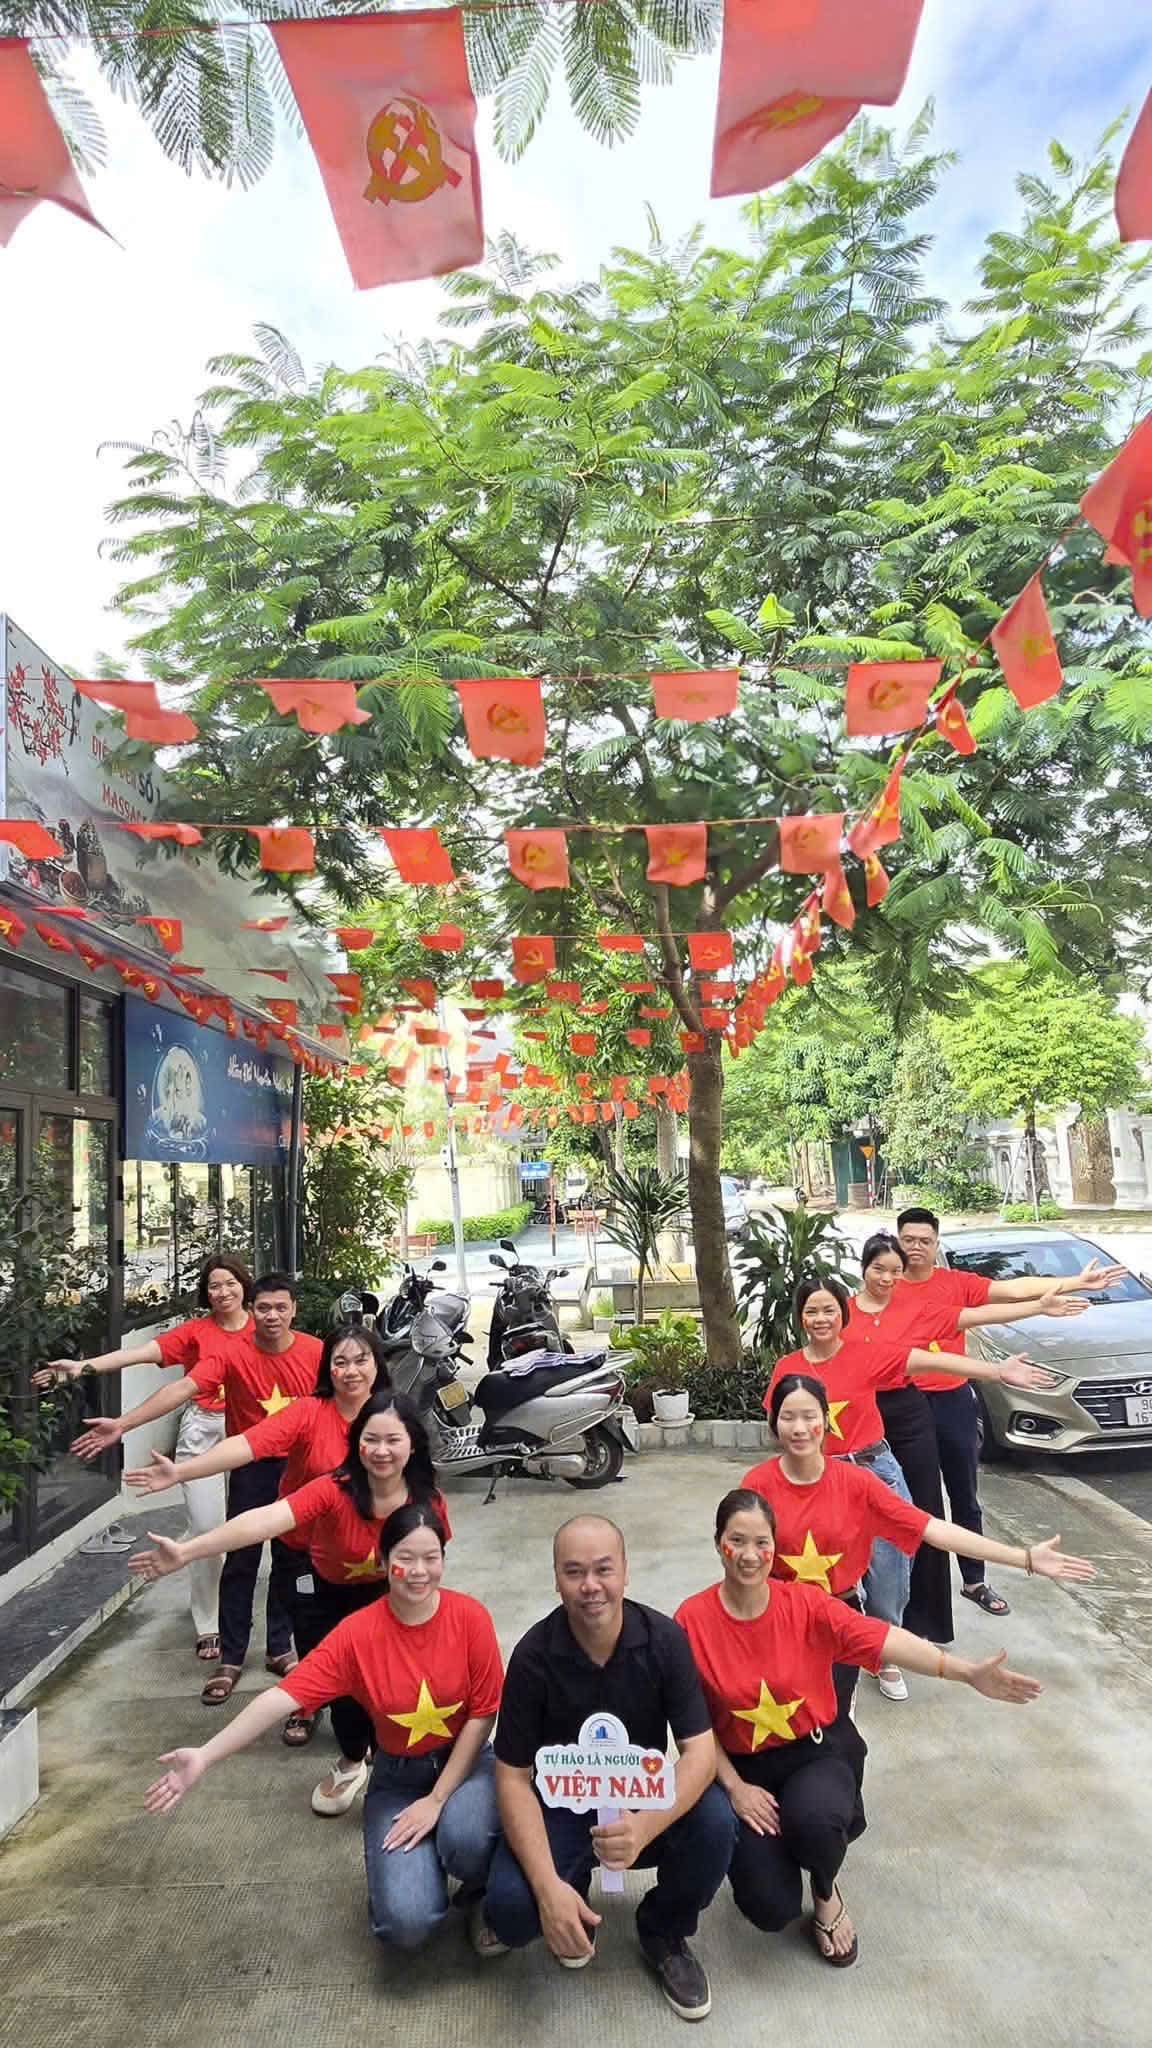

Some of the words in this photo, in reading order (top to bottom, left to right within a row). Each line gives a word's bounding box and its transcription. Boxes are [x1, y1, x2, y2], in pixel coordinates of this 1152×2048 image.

[544, 1753, 559, 1767] TỰ
[561, 1752, 585, 1765] HÀO
[587, 1752, 602, 1765] LÀ
[604, 1752, 640, 1766] NGƯỜI
[544, 1769, 602, 1803] VIỆT
[608, 1775, 665, 1798] NAM
